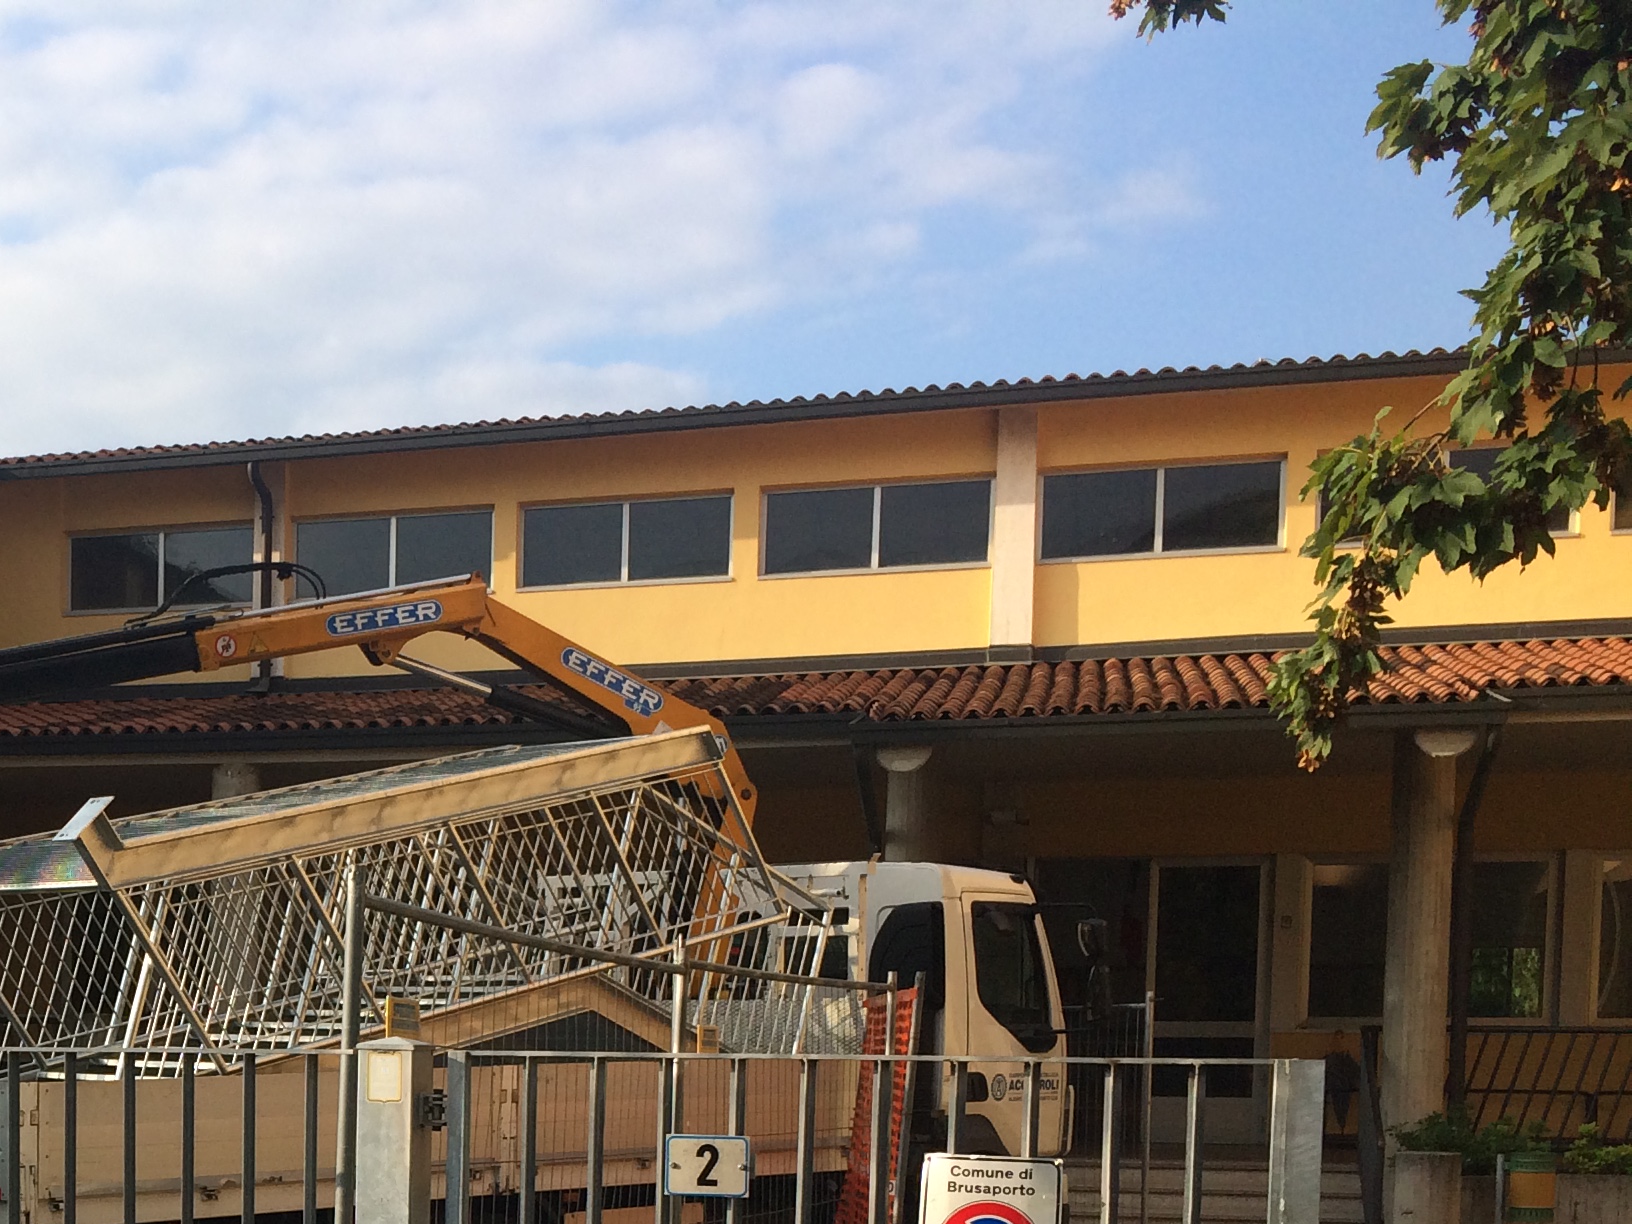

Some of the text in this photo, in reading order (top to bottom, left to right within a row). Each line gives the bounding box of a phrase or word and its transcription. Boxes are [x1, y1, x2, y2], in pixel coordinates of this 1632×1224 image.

[333, 602, 437, 633] EFFER
[568, 651, 660, 710] EFFER
[695, 1143, 719, 1187] 2
[950, 1165, 1034, 1180] Comune di
[947, 1181, 1036, 1197] Brusaporto
